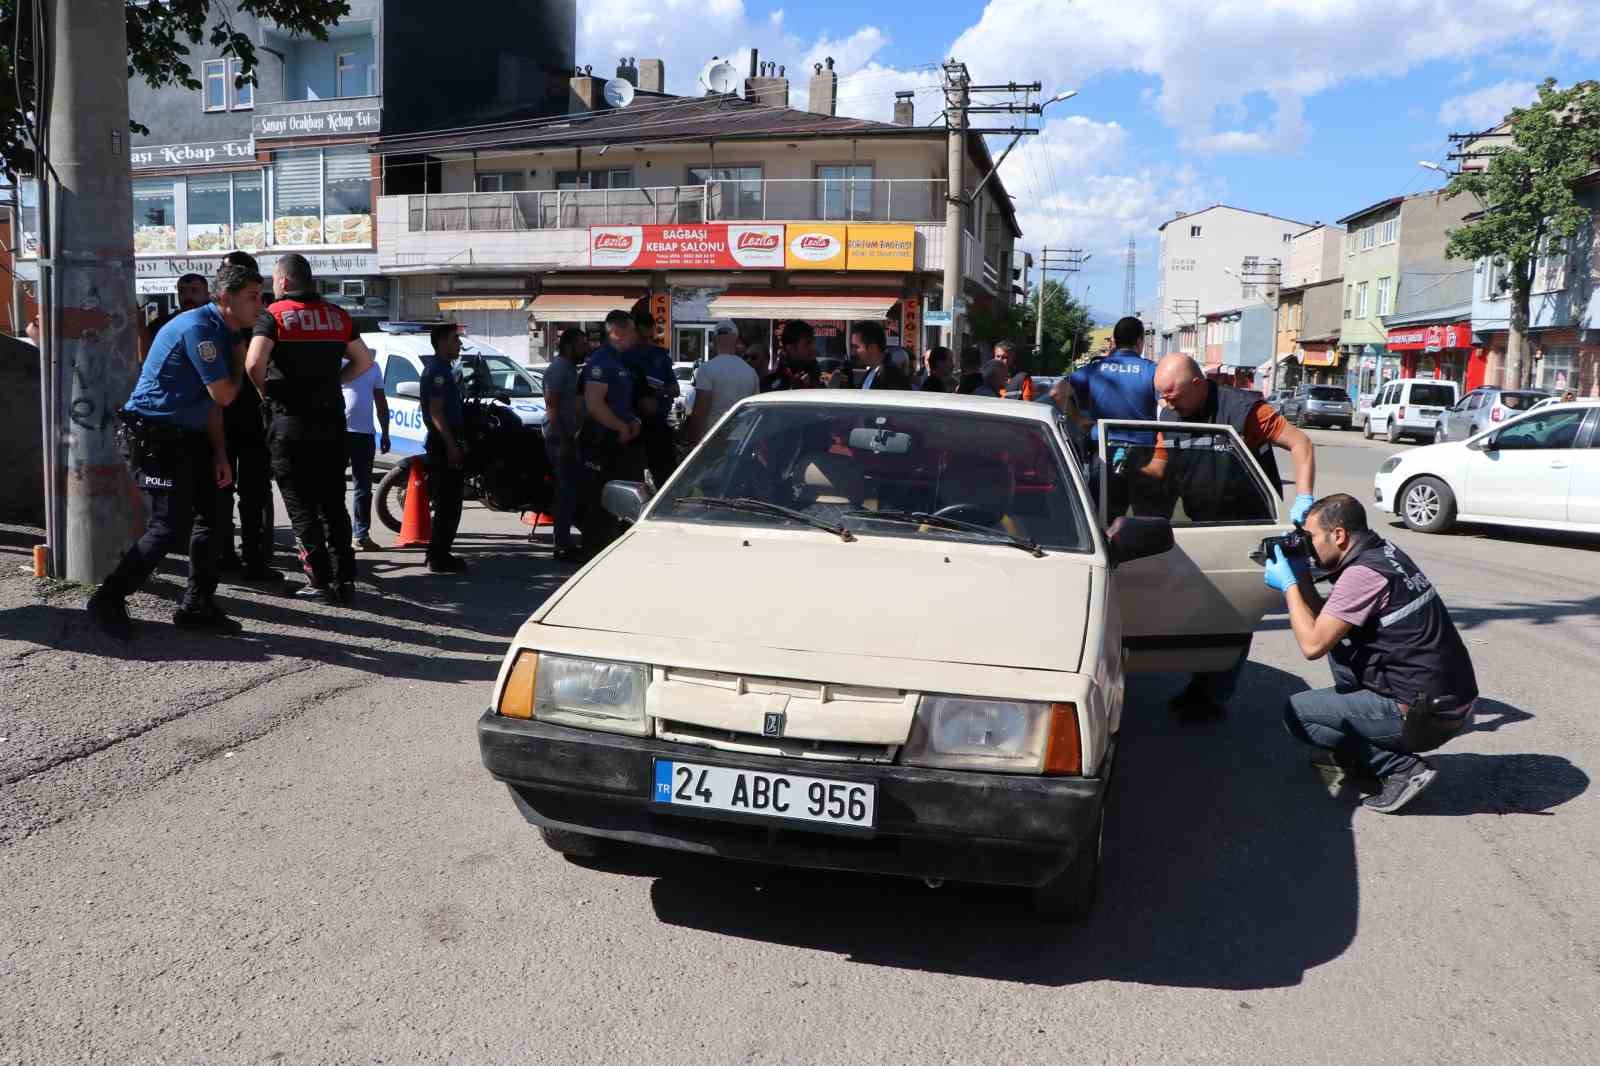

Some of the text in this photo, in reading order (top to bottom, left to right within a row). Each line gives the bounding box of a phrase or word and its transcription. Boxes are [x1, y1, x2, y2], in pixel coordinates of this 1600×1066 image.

[327, 112, 353, 131] Kebap
[131, 152, 152, 164] aşı
[160, 146, 216, 164] Kebap
[663, 226, 707, 241] BAĞBAŞI
[740, 231, 777, 247] Lezita
[646, 241, 725, 252] KEBAP SALONU
[164, 257, 213, 275] Kebap
[389, 407, 422, 430] POLİS
[657, 766, 867, 821] TR 24 ABC 956
